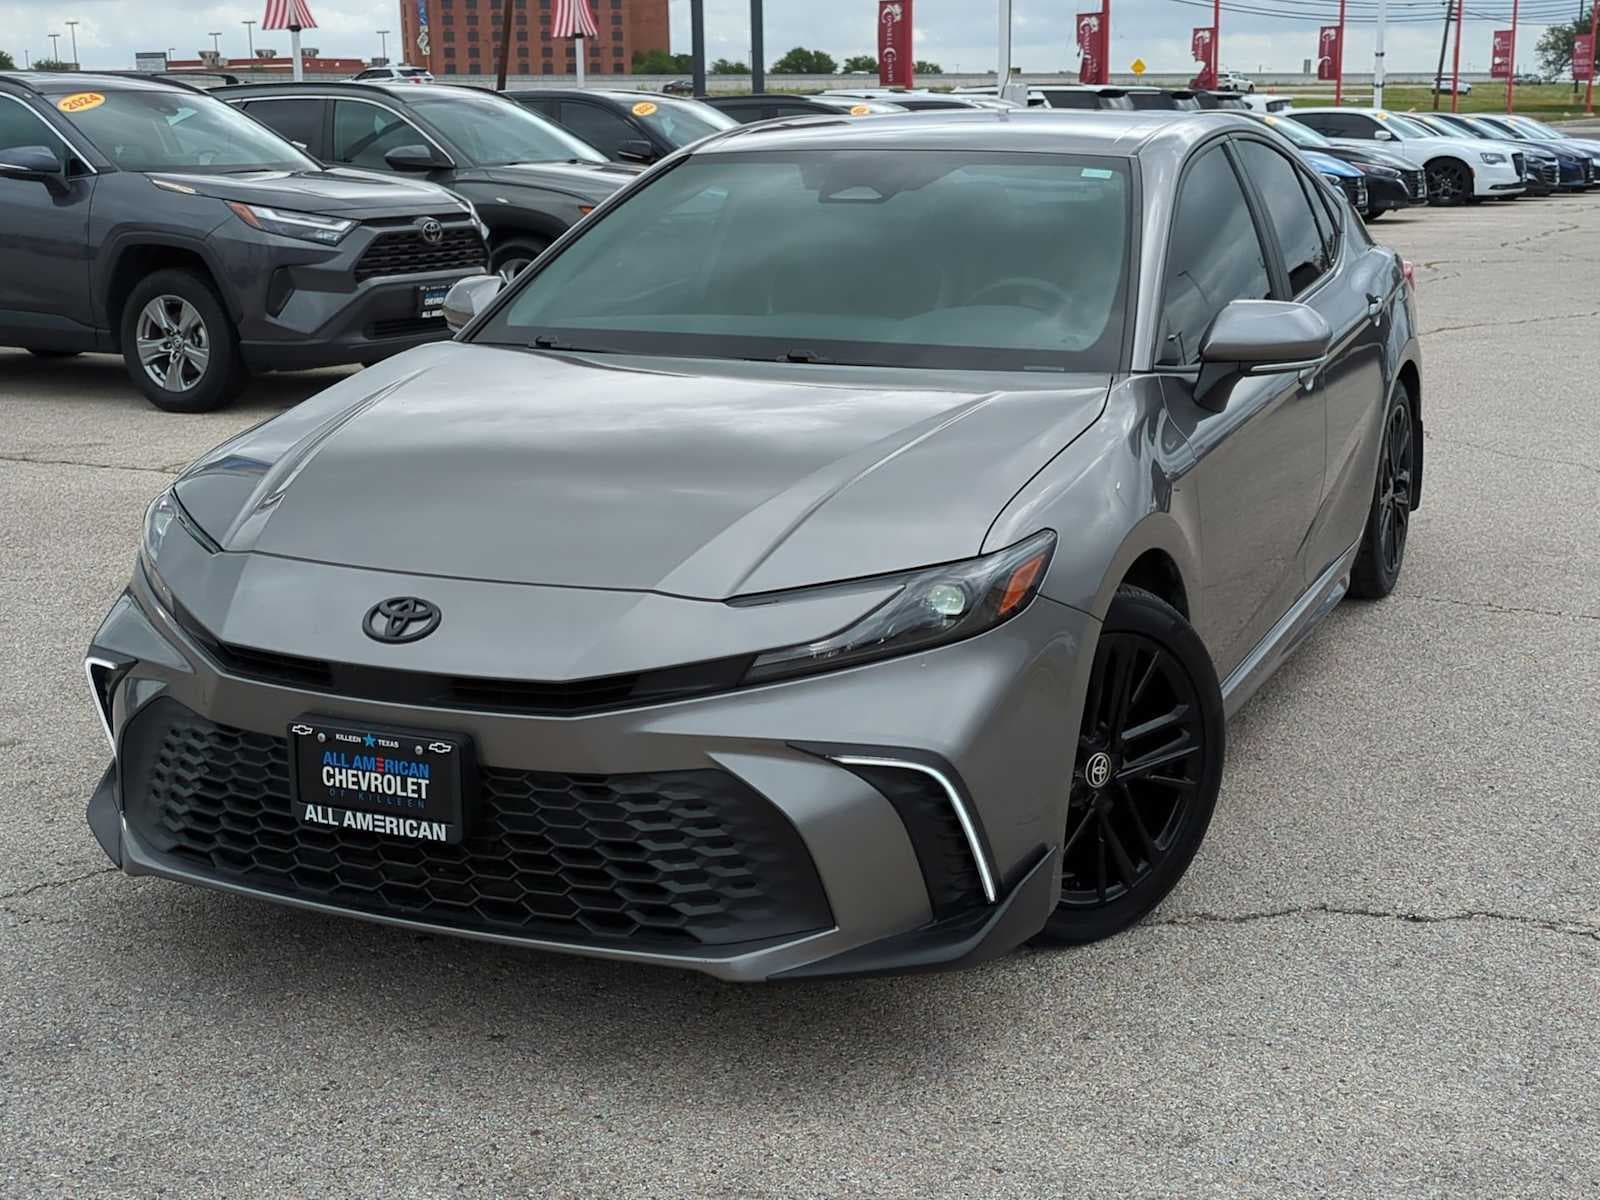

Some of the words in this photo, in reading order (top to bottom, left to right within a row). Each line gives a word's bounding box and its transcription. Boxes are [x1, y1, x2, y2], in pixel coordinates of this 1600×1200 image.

[63, 95, 101, 110] 2024
[336, 733, 362, 743] KILLEEN
[378, 739, 399, 749] TEXAS
[322, 751, 349, 767] ALL
[352, 754, 430, 778] AMERICAN
[322, 766, 430, 799] CHEVROLET
[358, 792, 425, 809] KILLEEN
[305, 804, 339, 826] ALL
[343, 810, 446, 842] AMERICAN
